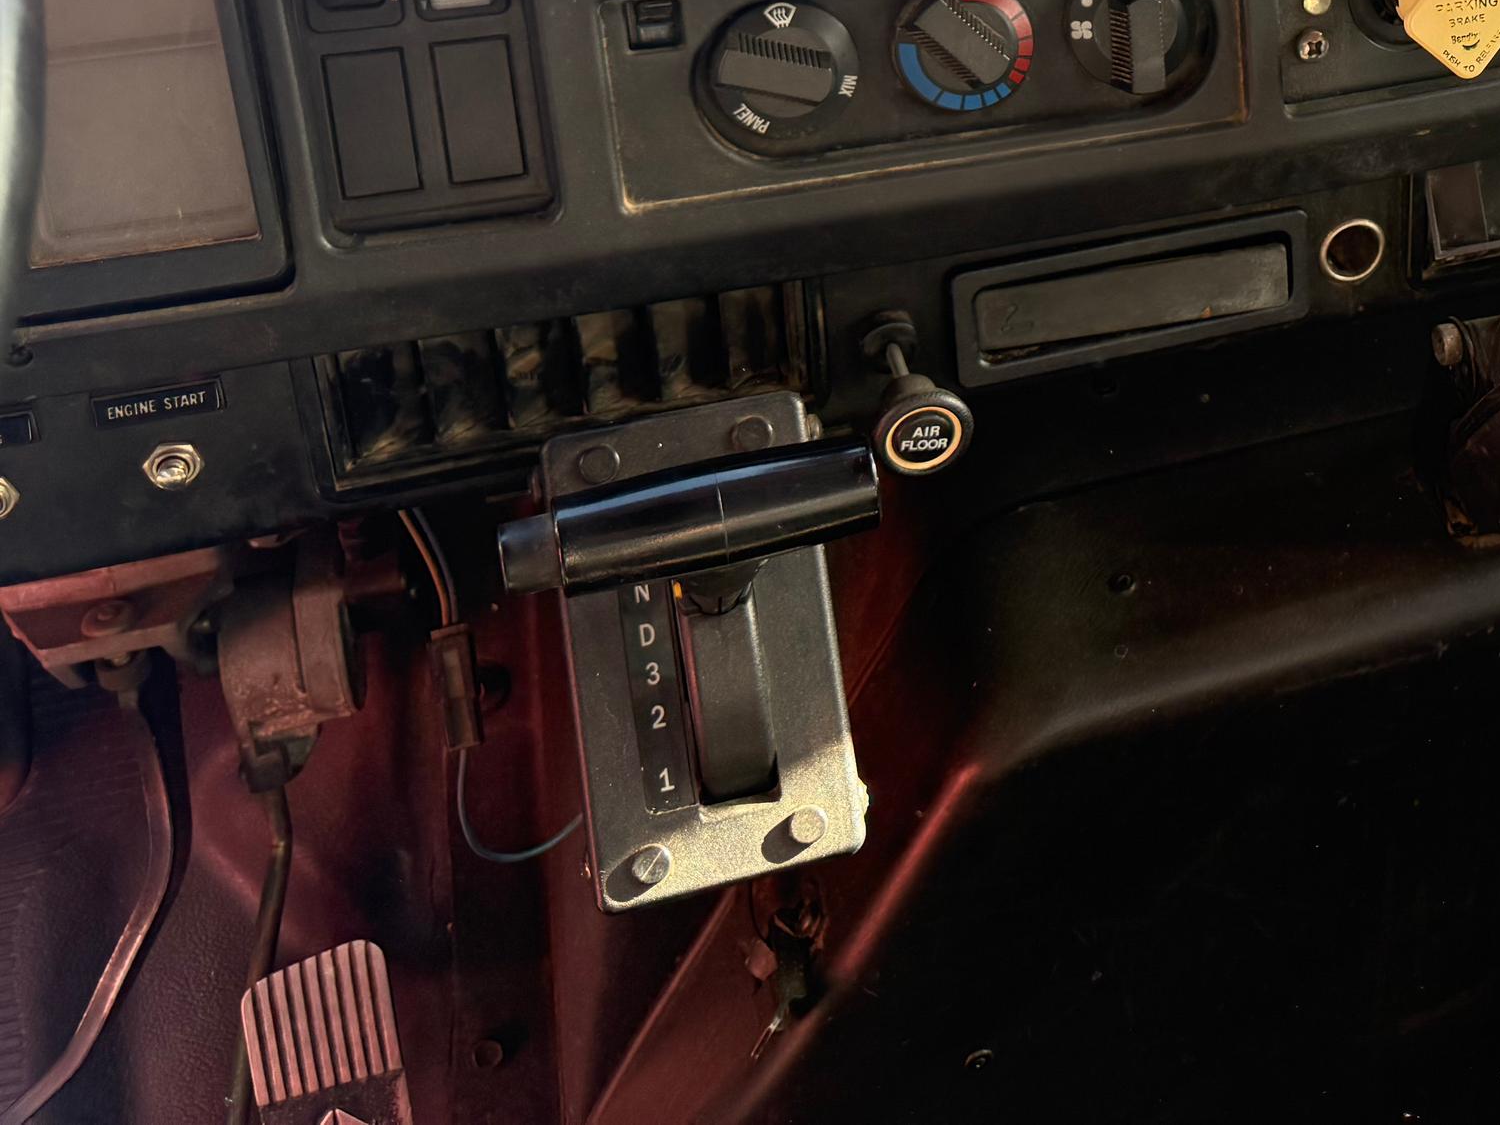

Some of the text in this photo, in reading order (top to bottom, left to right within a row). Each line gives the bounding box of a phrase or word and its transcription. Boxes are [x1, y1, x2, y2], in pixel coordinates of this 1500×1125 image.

[1449, 14, 1485, 28] BRAKE
[1443, 50, 1461, 67] PUSH
[1463, 65, 1475, 73] TO
[838, 75, 858, 97] MIX
[732, 103, 771, 134] PANEL
[107, 391, 206, 420] ENGINE START
[912, 425, 940, 438] AIR
[901, 438, 948, 452] FLOOR
[634, 584, 650, 603] N
[639, 623, 656, 647] D
[645, 662, 661, 685] 3
[651, 704, 667, 729] 2
[659, 767, 675, 792] 1
